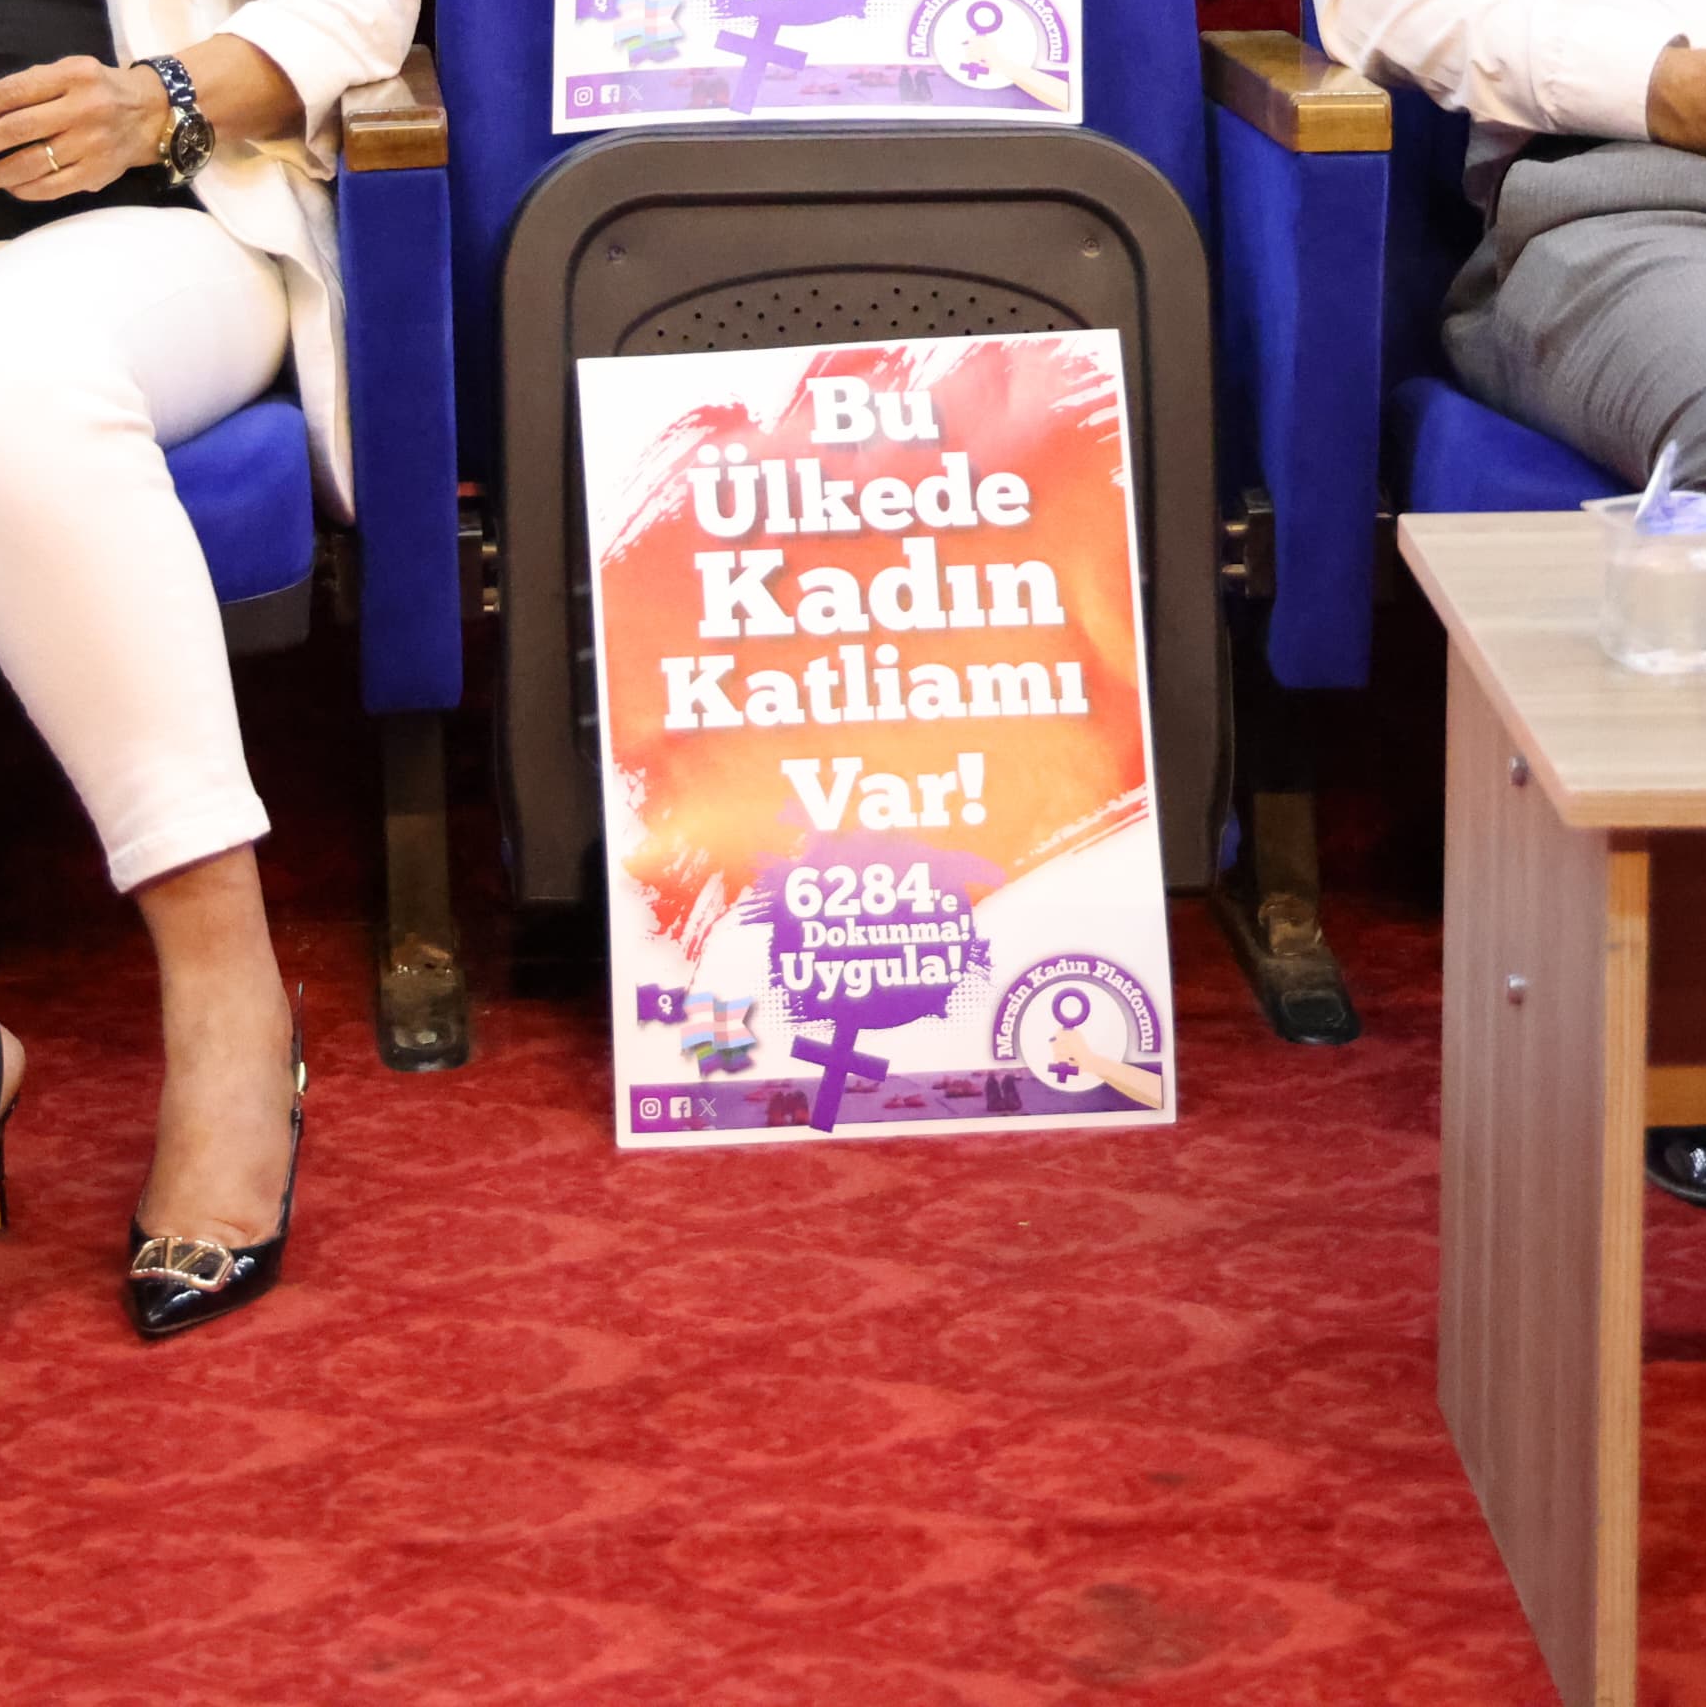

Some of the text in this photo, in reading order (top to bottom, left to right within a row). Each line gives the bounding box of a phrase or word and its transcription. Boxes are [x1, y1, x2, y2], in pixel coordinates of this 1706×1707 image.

[805, 375, 939, 444] Bu
[687, 442, 1031, 537] Ülkede
[694, 536, 1065, 638] Kadın
[661, 643, 1089, 730] Katliamı
[781, 752, 987, 830] Var!
[801, 914, 971, 948] Dokunma!
[779, 945, 964, 1001] Uygula!
[996, 958, 1155, 1058] Mersin Kadın Platformu
